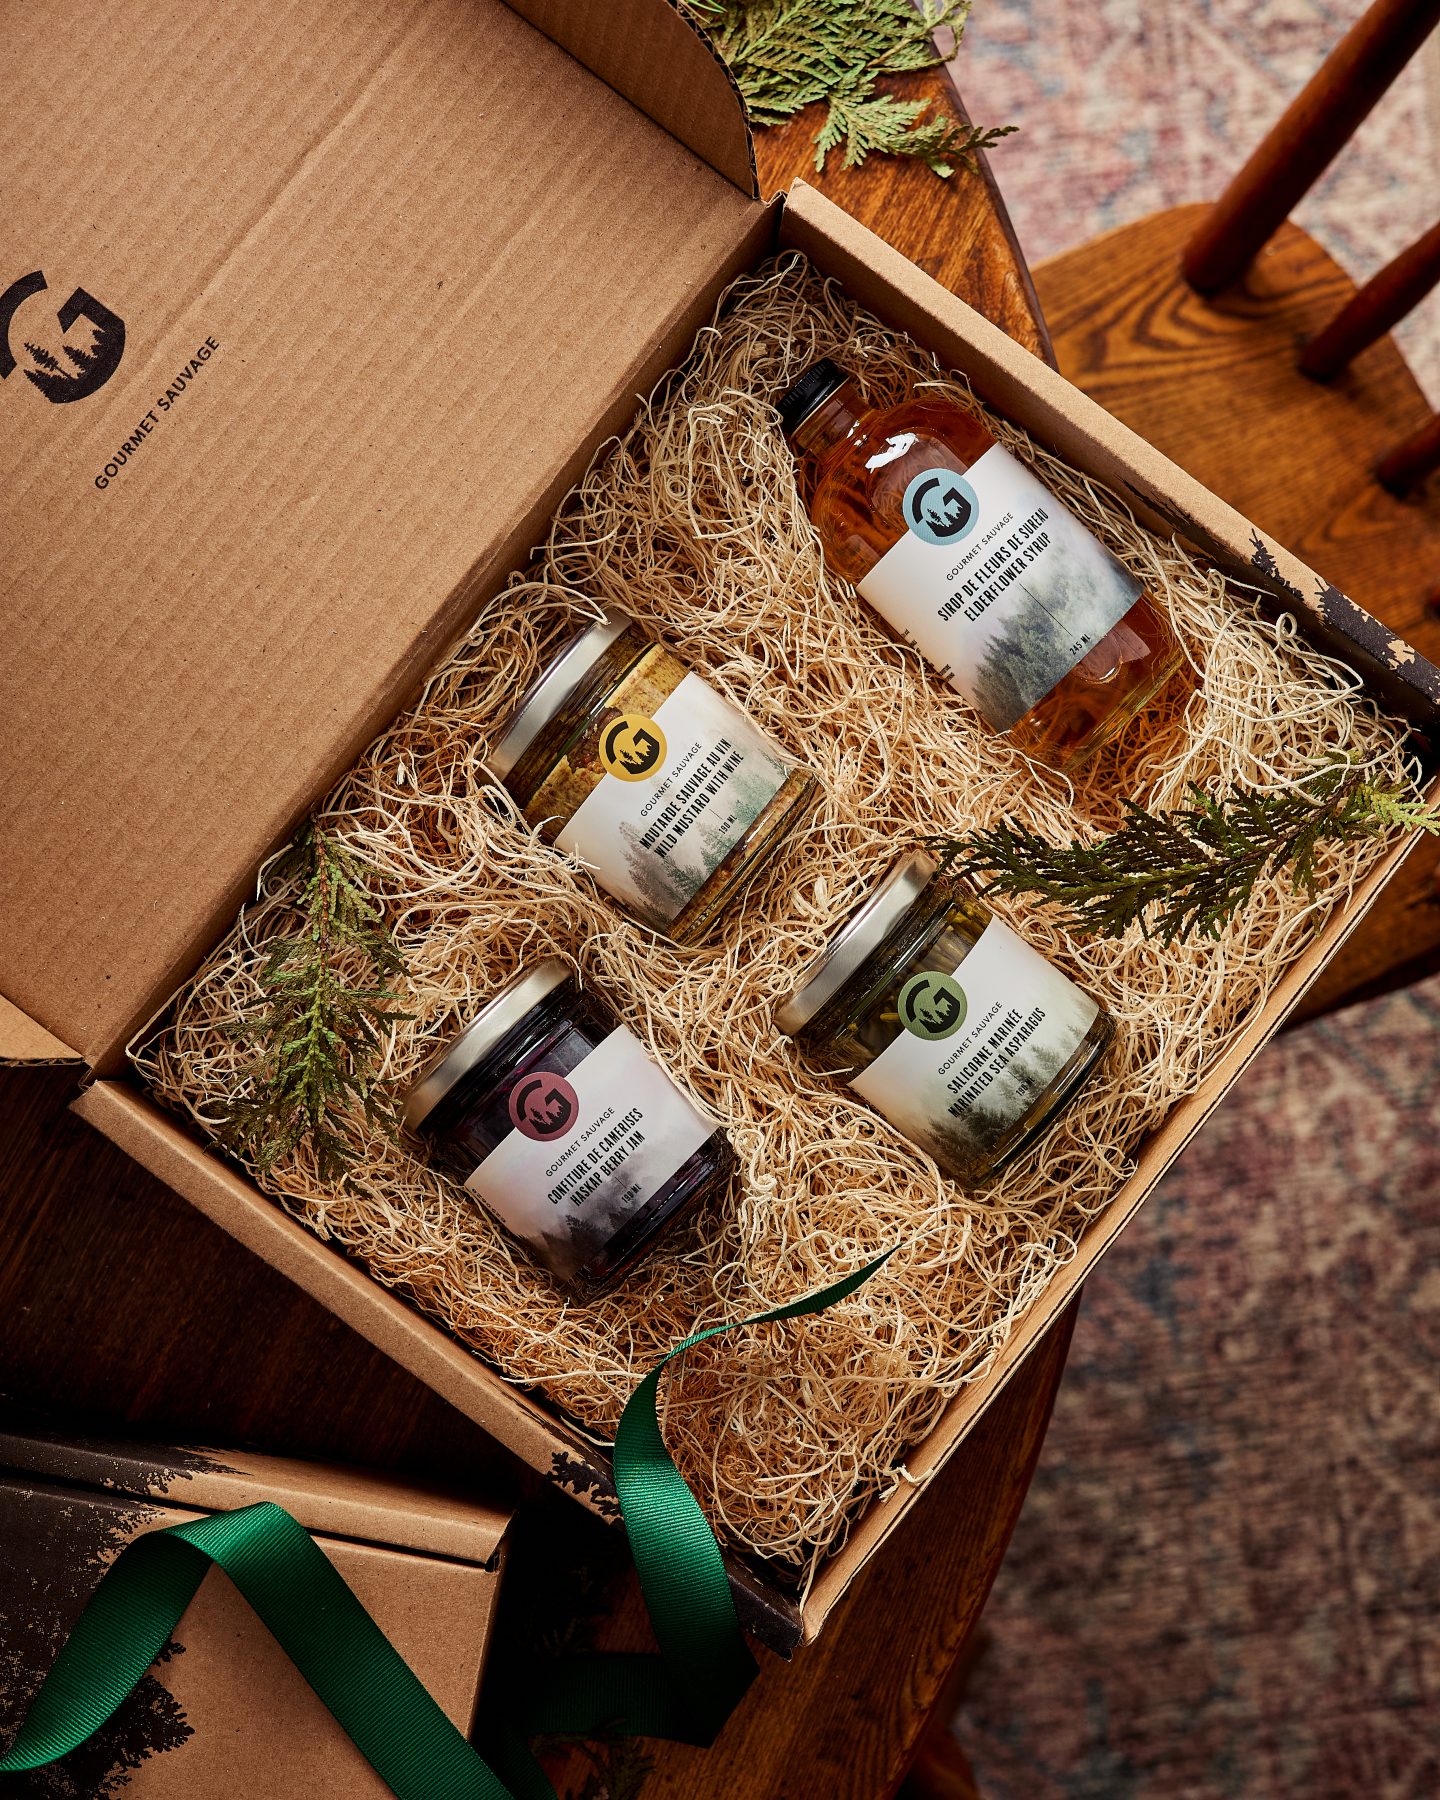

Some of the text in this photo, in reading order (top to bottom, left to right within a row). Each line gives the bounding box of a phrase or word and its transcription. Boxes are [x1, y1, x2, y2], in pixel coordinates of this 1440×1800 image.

[94, 336, 220, 490] GOURMET SAUVAGE
[937, 508, 1048, 622] SIROP DE FLEURS DE SUREAU
[946, 512, 1014, 581] GOURMET SAUVAGE
[963, 532, 1051, 622] ELDERFLOWER SYRUP
[1069, 633, 1091, 655] 245 ML
[639, 738, 732, 850] MOUTARDE SAUVAGE AU VIN
[640, 742, 702, 817] GOURMET SAUVAGE
[654, 750, 744, 858] WILD MUSTARD WITH WINE
[718, 814, 737, 835] 190 ML
[938, 1001, 1003, 1075] GOURMET SAUVAGE
[947, 1008, 1023, 1094] SALICORNE MARINÉE
[948, 1007, 1046, 1118] MARINATED SEA ASPARAGUS
[545, 1107, 615, 1177] GOURMET SAUVAGE
[547, 1107, 643, 1205] CONFITURE DE CAMERISES
[570, 1130, 645, 1207] HASKAP BERRY JAM
